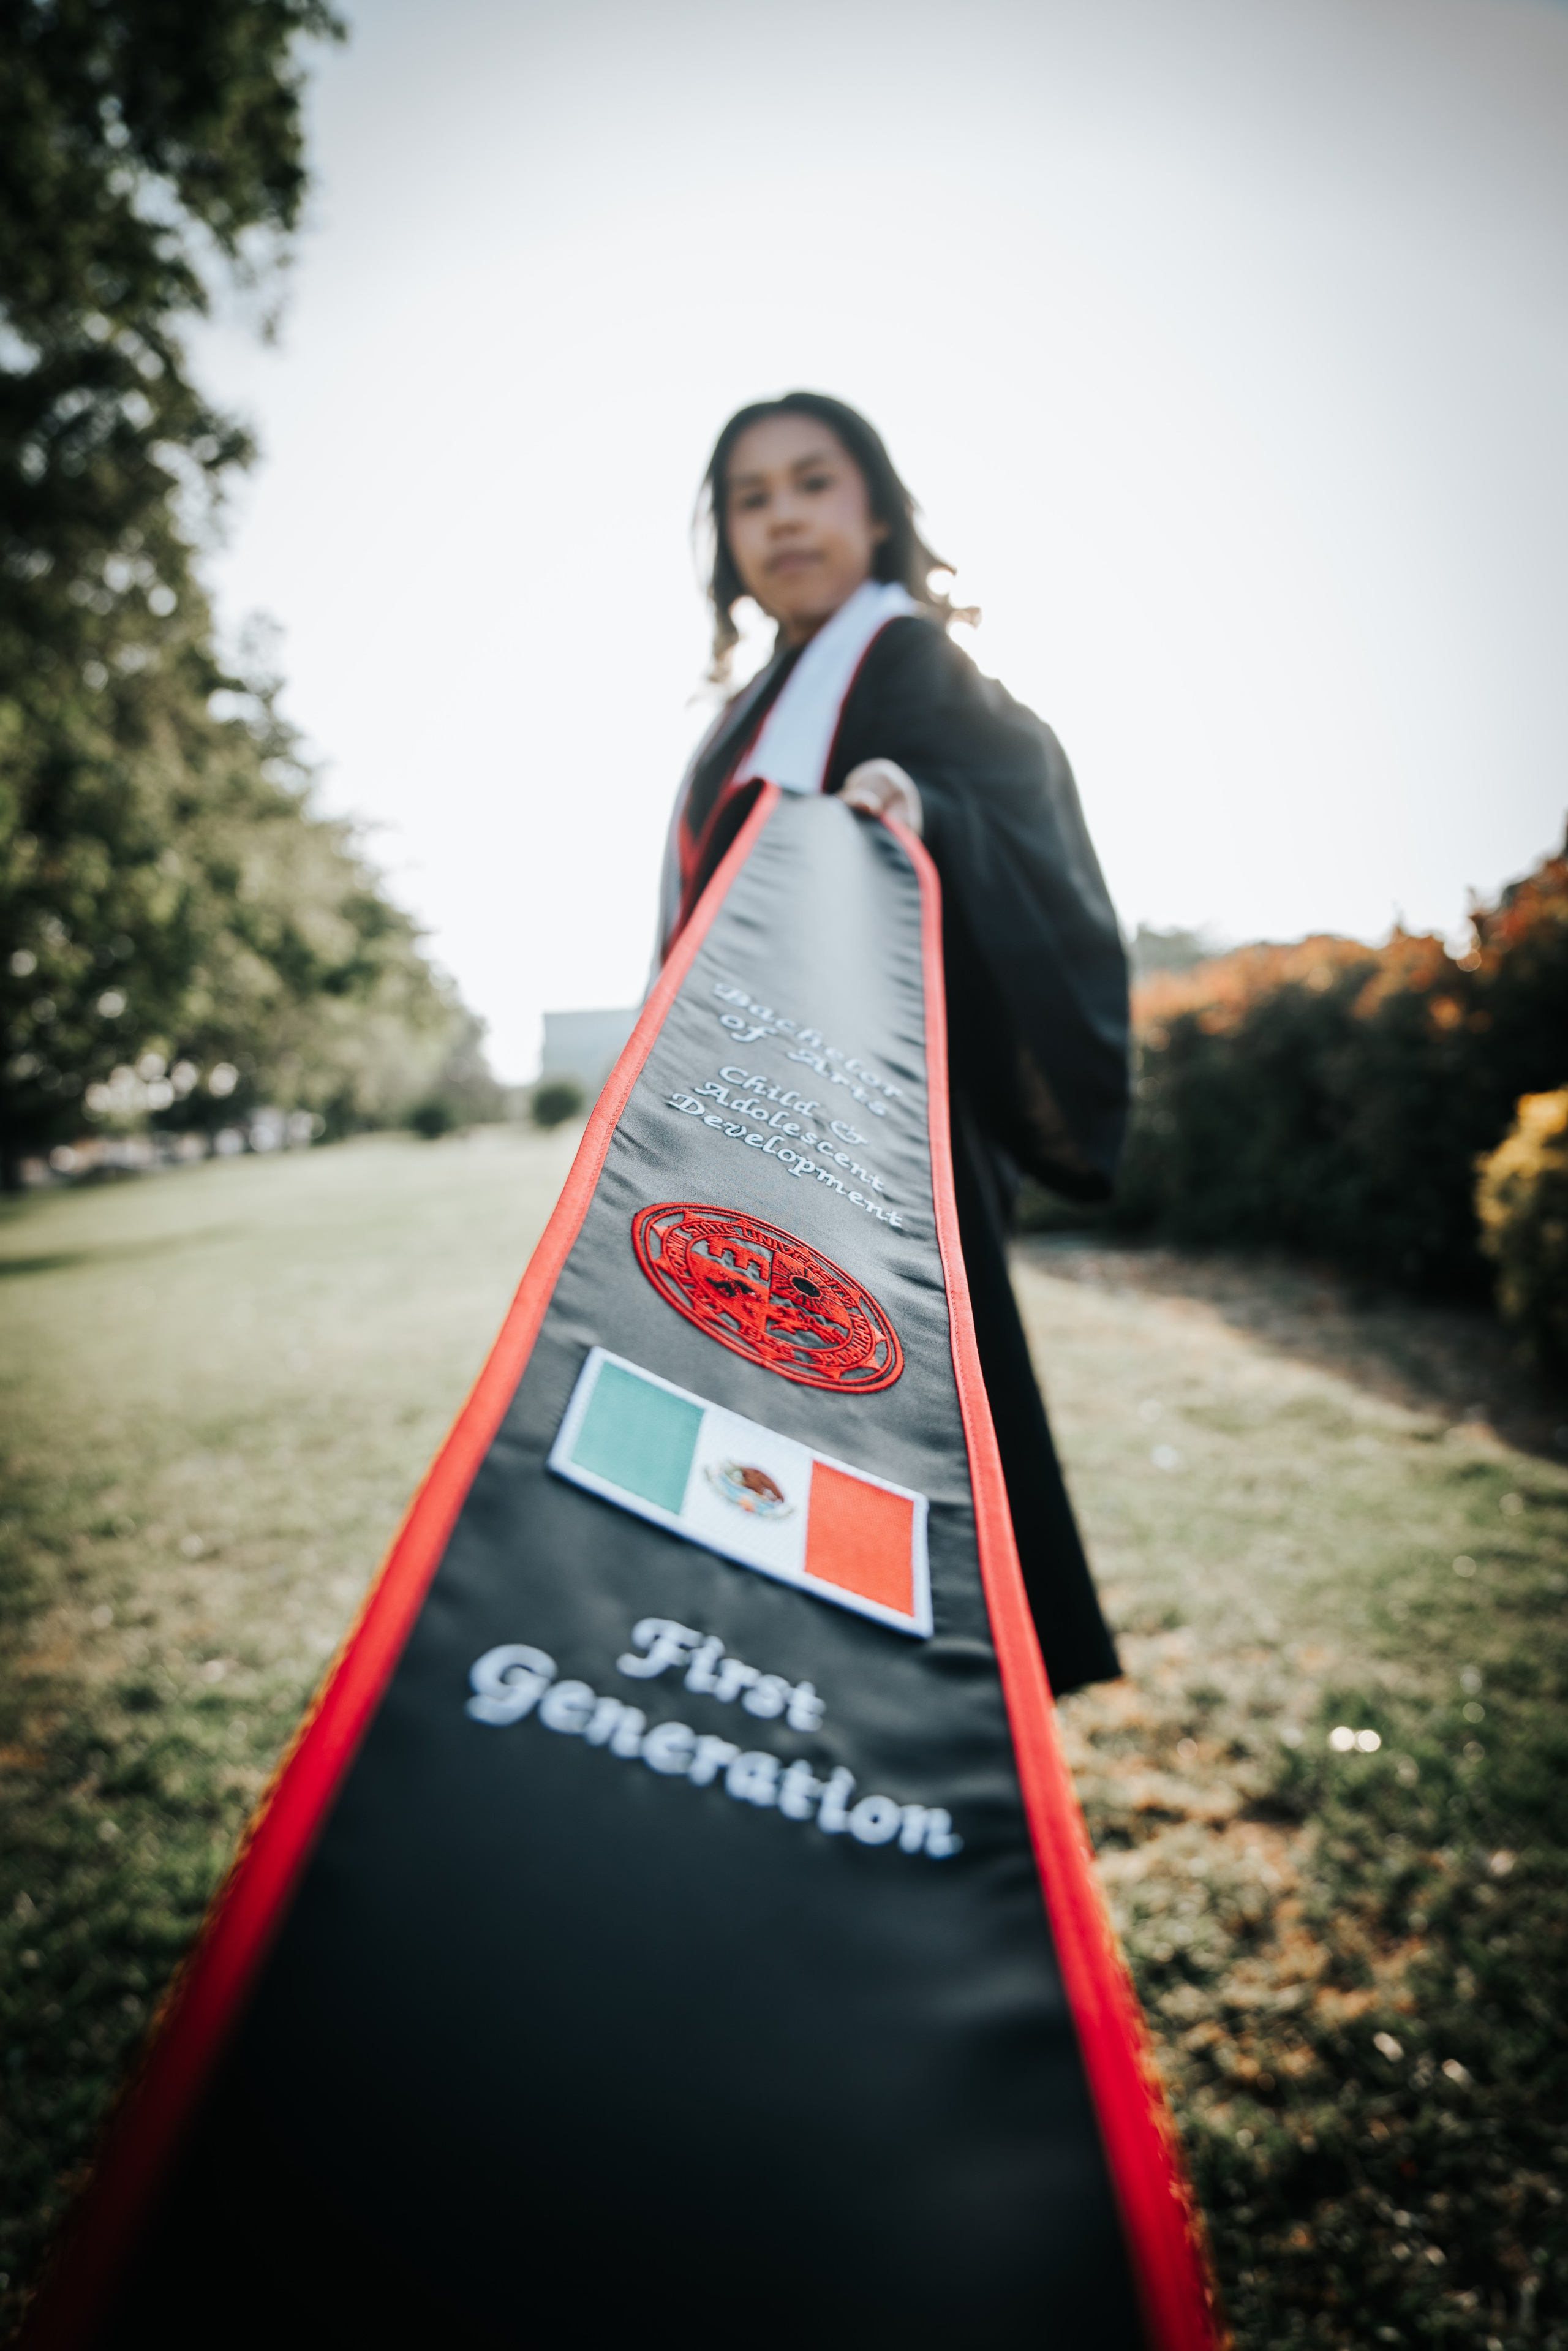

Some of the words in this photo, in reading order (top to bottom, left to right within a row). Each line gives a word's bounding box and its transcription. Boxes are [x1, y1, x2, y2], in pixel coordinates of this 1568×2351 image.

[713, 981, 905, 1099] Bachelor
[719, 1013, 779, 1043] of
[786, 1047, 889, 1118] Arts
[668, 1092, 903, 1228] Development
[695, 1081, 885, 1192] Adolescent
[719, 1065, 821, 1118] Child
[829, 1119, 869, 1145] &
[680, 1221, 739, 1237] STATE
[809, 1311, 872, 1367] NORTHRIDGE
[616, 1616, 827, 1734] First
[464, 1643, 965, 1860] Generation
